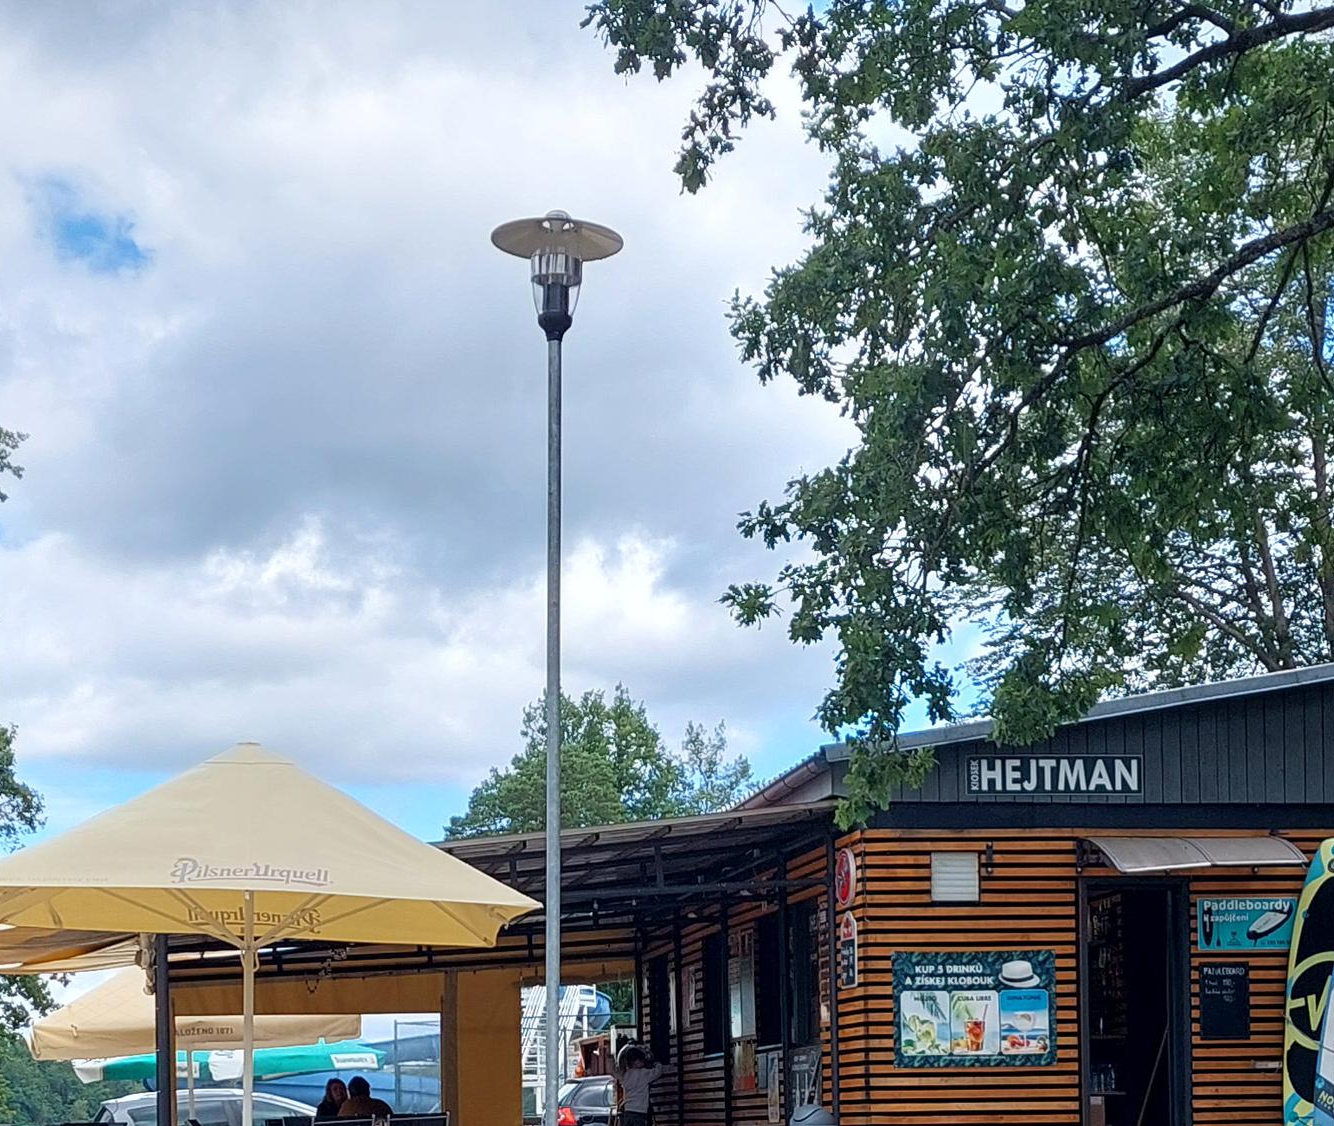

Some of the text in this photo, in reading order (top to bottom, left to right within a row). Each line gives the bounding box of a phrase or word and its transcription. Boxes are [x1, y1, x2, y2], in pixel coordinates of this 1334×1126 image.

[970, 759, 979, 791] KIOSEK
[980, 758, 1139, 791] HEJTMAN
[1203, 899, 1291, 912] Paddleboardy
[915, 965, 935, 973] KUP
[945, 962, 983, 973] DRINKŮ
[904, 974, 995, 986] A ZÍSKEJ KLOBOUK
[174, 1027, 214, 1037] ALOŽENO
